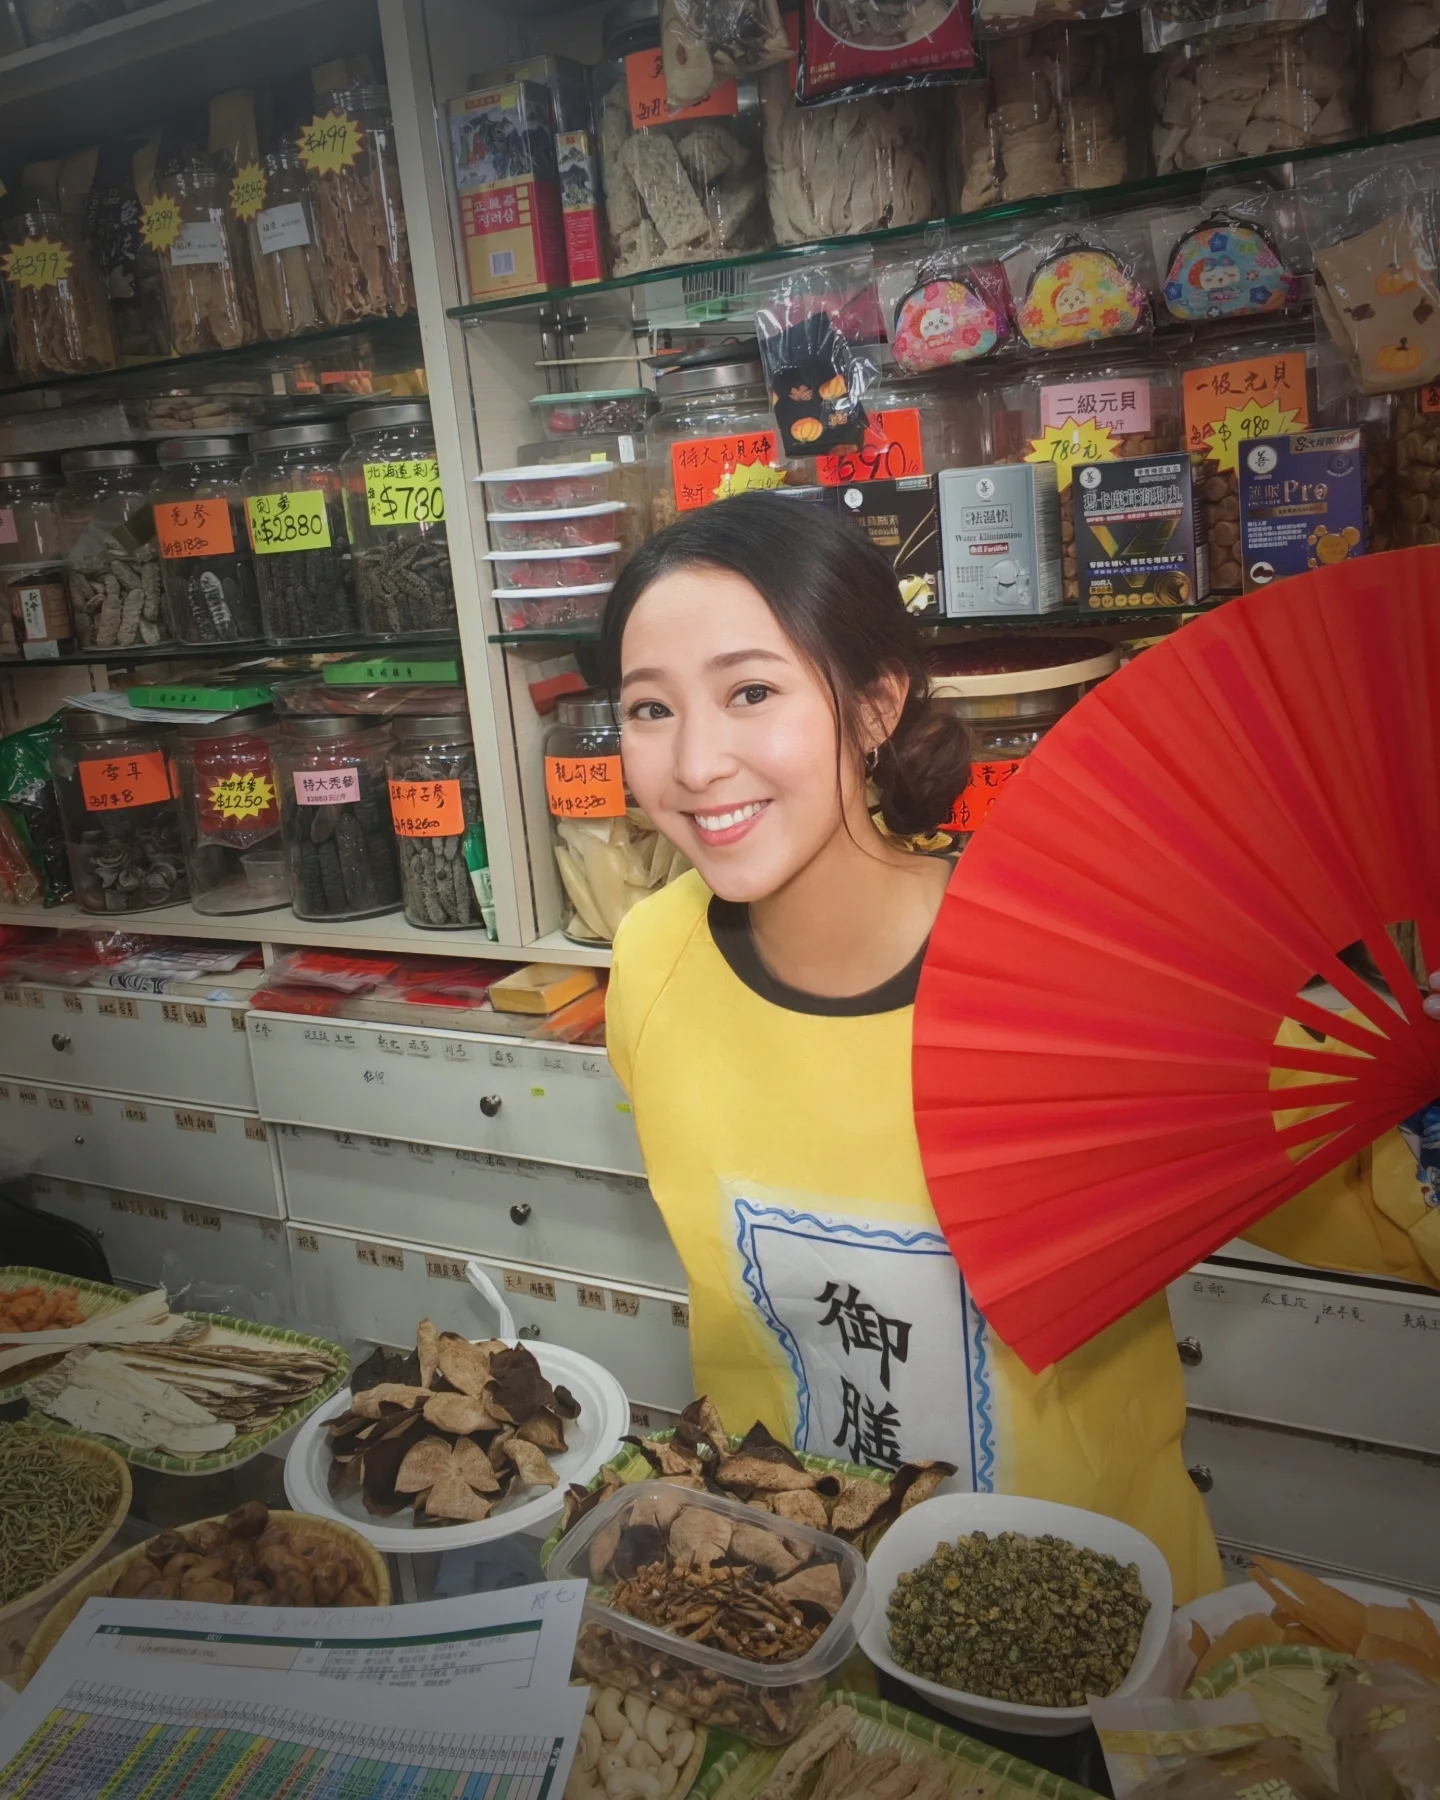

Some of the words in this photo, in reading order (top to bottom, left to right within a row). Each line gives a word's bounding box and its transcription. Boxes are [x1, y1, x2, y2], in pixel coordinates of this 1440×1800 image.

[305, 125, 347, 154] $499
[146, 210, 173, 234] $399
[12, 252, 60, 280] $399
[1056, 391, 1137, 416] 二級元貝
[380, 484, 445, 521] $780
[1284, 480, 1328, 503] Pro
[261, 514, 323, 545] $2880
[955, 534, 977, 542] Water
[979, 532, 1023, 541] Elimination
[102, 762, 143, 781] 雪耳
[216, 795, 263, 810] $1250
[1193, 1281, 1225, 1298] 百部
[814, 1279, 913, 1472] 御膳
